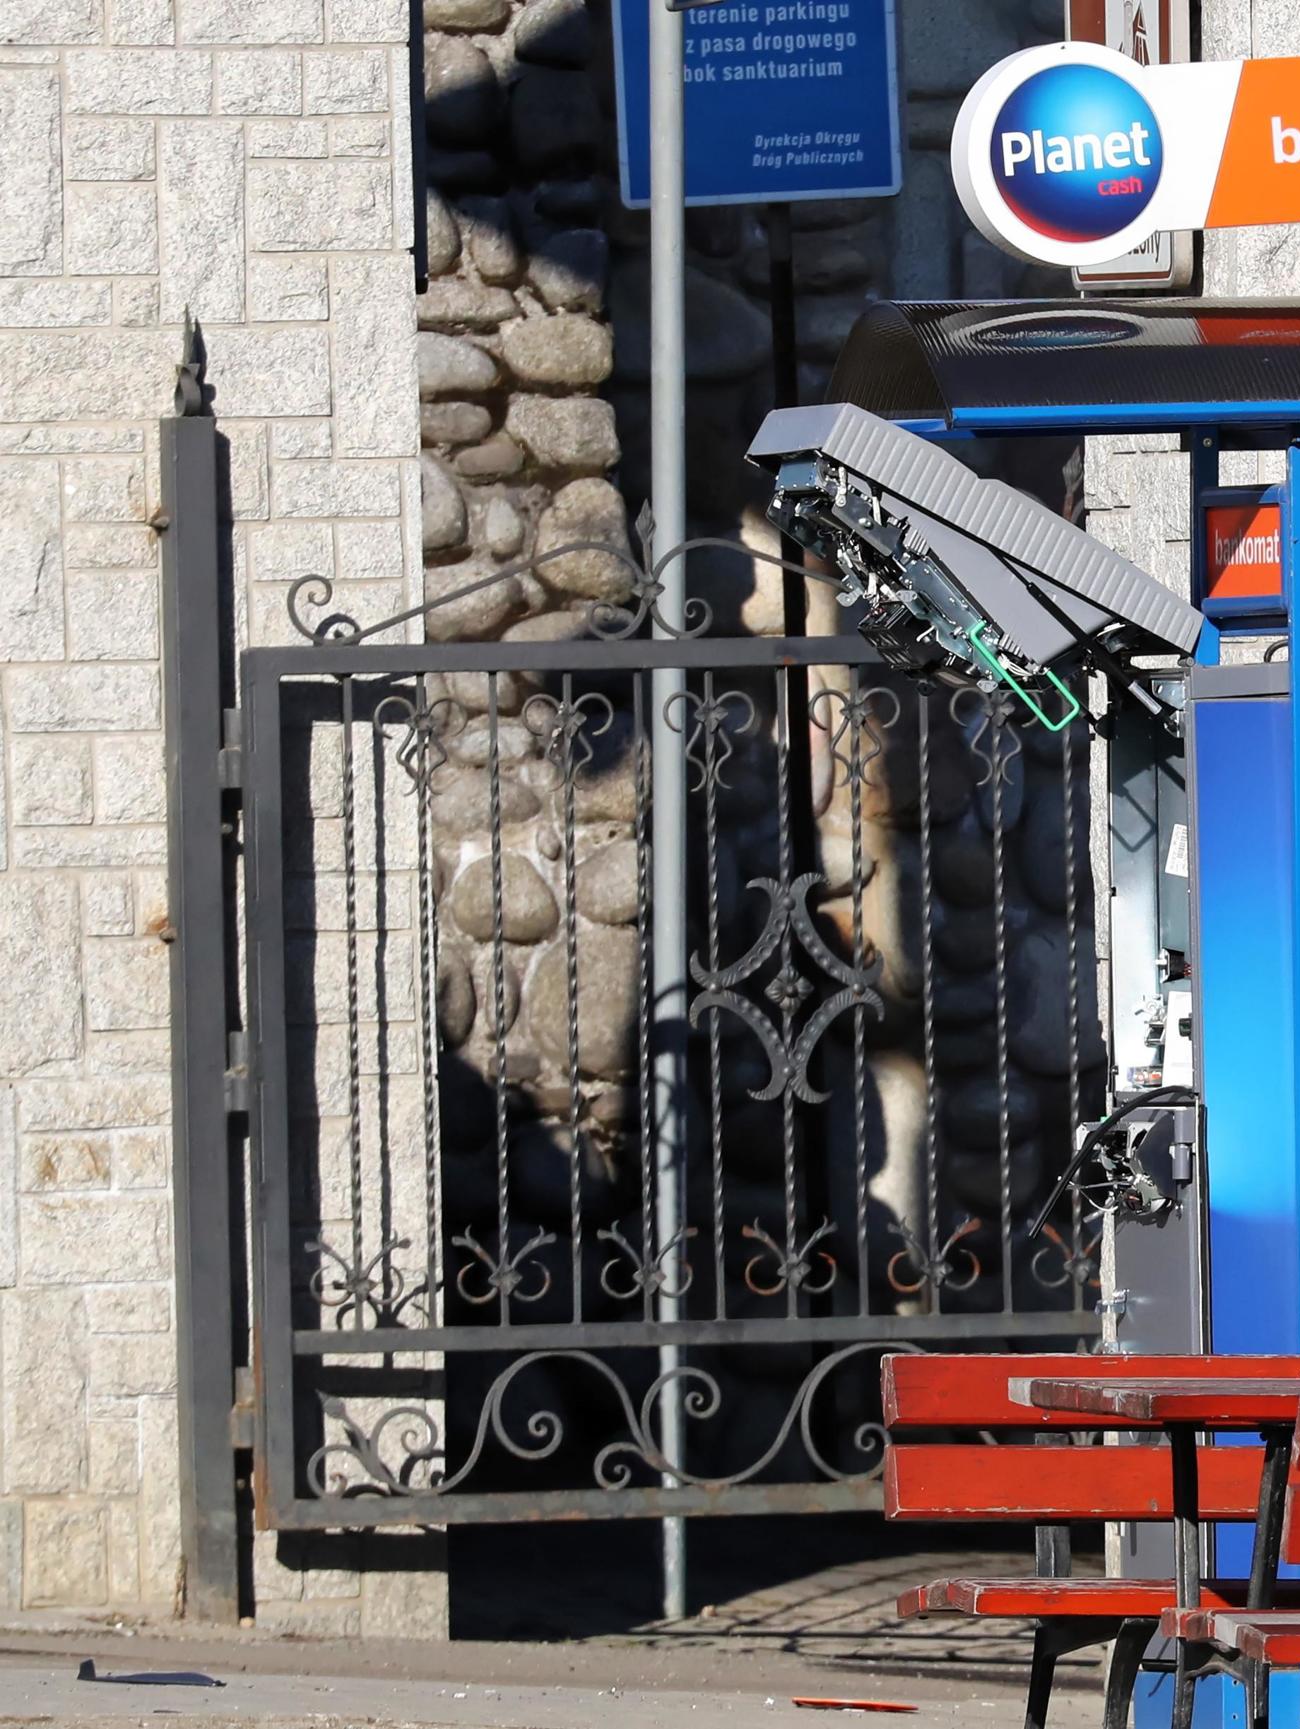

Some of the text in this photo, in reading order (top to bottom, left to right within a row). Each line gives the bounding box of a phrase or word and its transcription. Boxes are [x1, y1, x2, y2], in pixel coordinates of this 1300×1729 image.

[688, 2, 850, 26] terenie parkingu
[686, 31, 857, 58] z pasa drogowego
[683, 59, 844, 82] bok sanktuarium
[754, 131, 860, 150] Dyrekcja Okręgu
[1001, 121, 1151, 177] Planet
[752, 149, 864, 168] Dróg Publicznych
[1097, 176, 1142, 196] cash
[1215, 528, 1280, 565] bankomat
